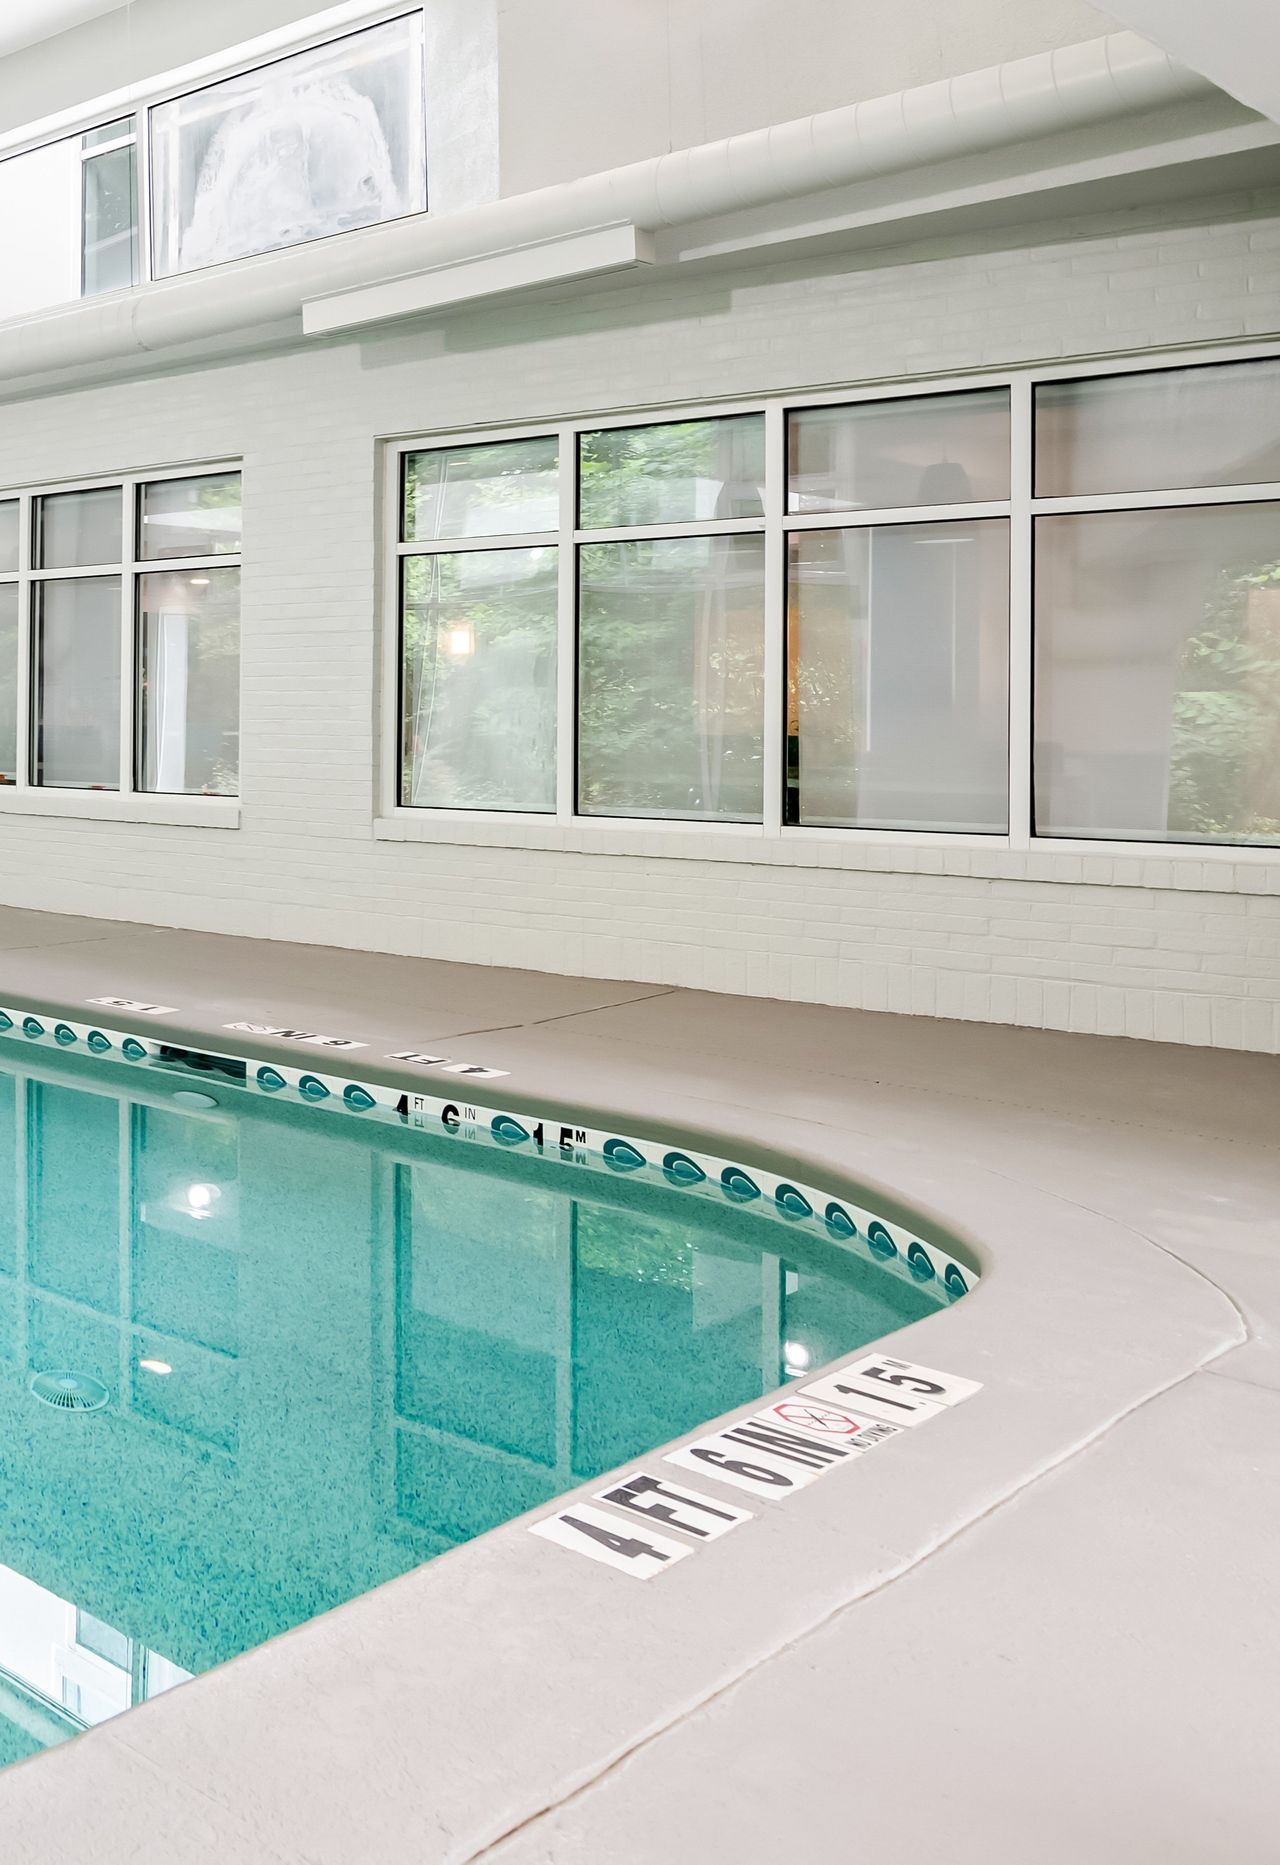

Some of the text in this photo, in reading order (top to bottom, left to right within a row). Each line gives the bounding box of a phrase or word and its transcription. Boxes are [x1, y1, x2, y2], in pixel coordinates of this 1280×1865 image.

[271, 1029, 490, 1074] 4 FT 6 IN
[414, 1096, 425, 1111] FT
[464, 1106, 476, 1121] IN
[844, 1423, 899, 1450] NO DIVING
[558, 1421, 851, 1563] 4 FT 6 IN
